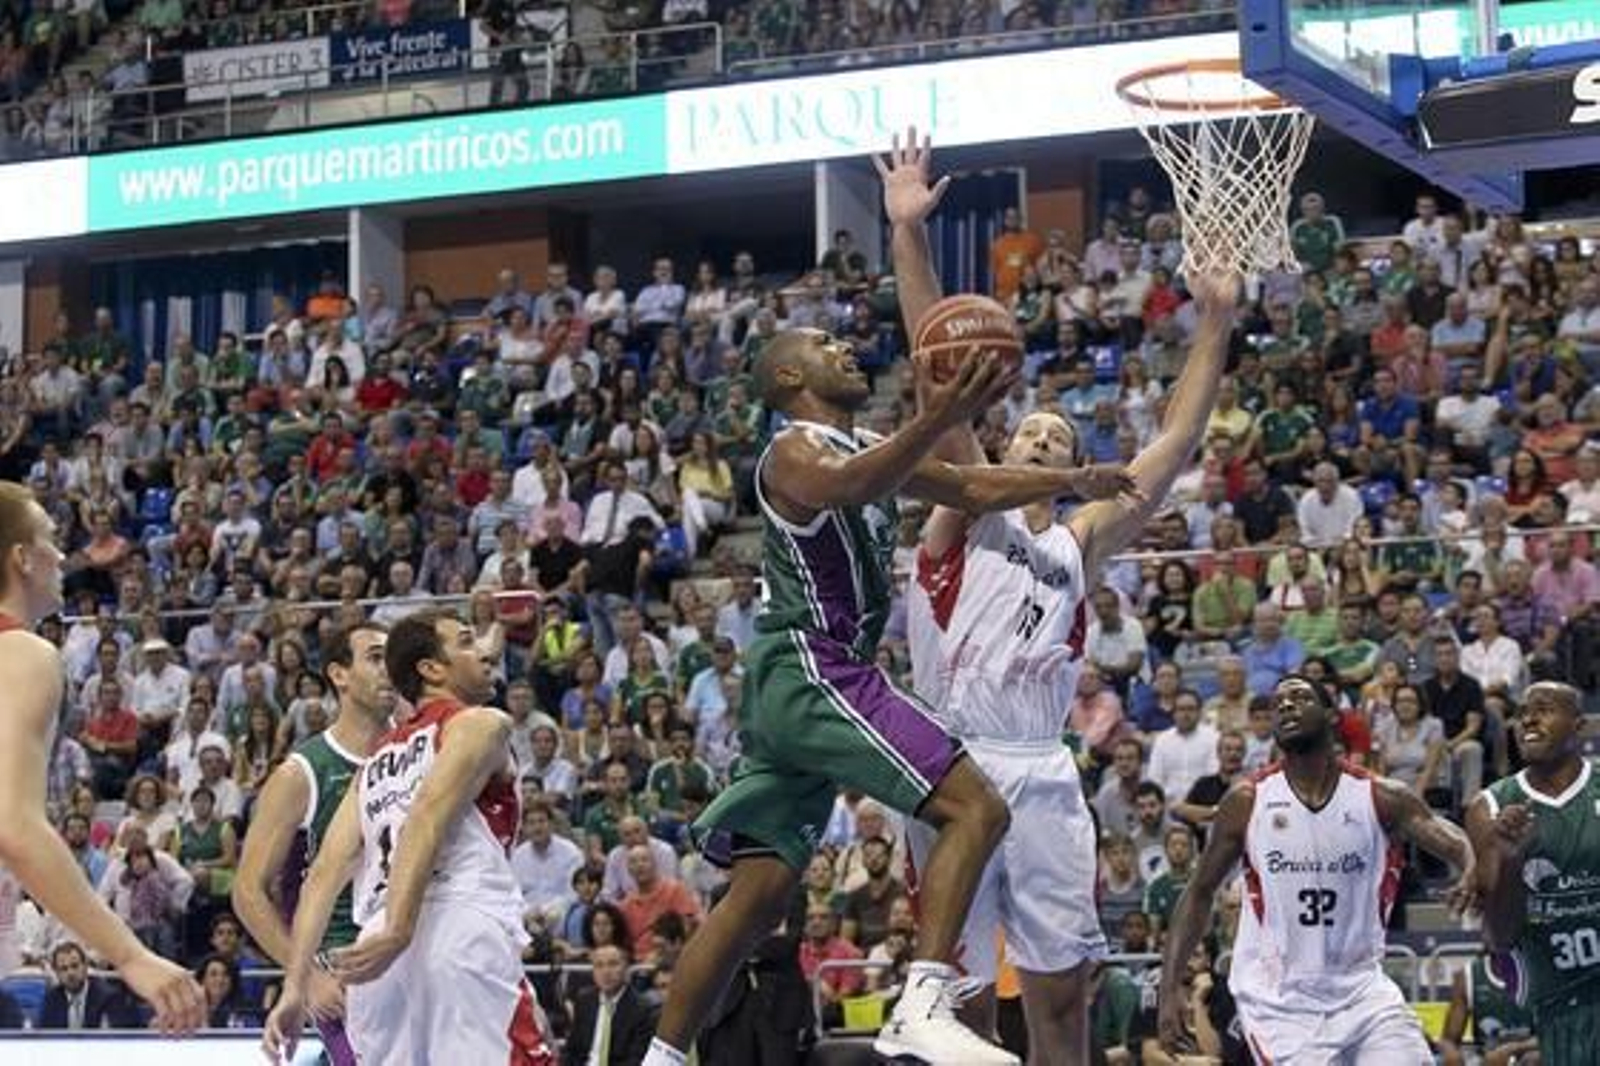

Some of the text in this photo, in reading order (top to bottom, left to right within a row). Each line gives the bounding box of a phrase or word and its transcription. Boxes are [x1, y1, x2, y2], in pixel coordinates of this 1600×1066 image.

[346, 31, 447, 58] Vive frente
[118, 115, 624, 208] www.parquemartiricos.com
[1298, 887, 1338, 927] 32
[1551, 927, 1600, 970] 30
